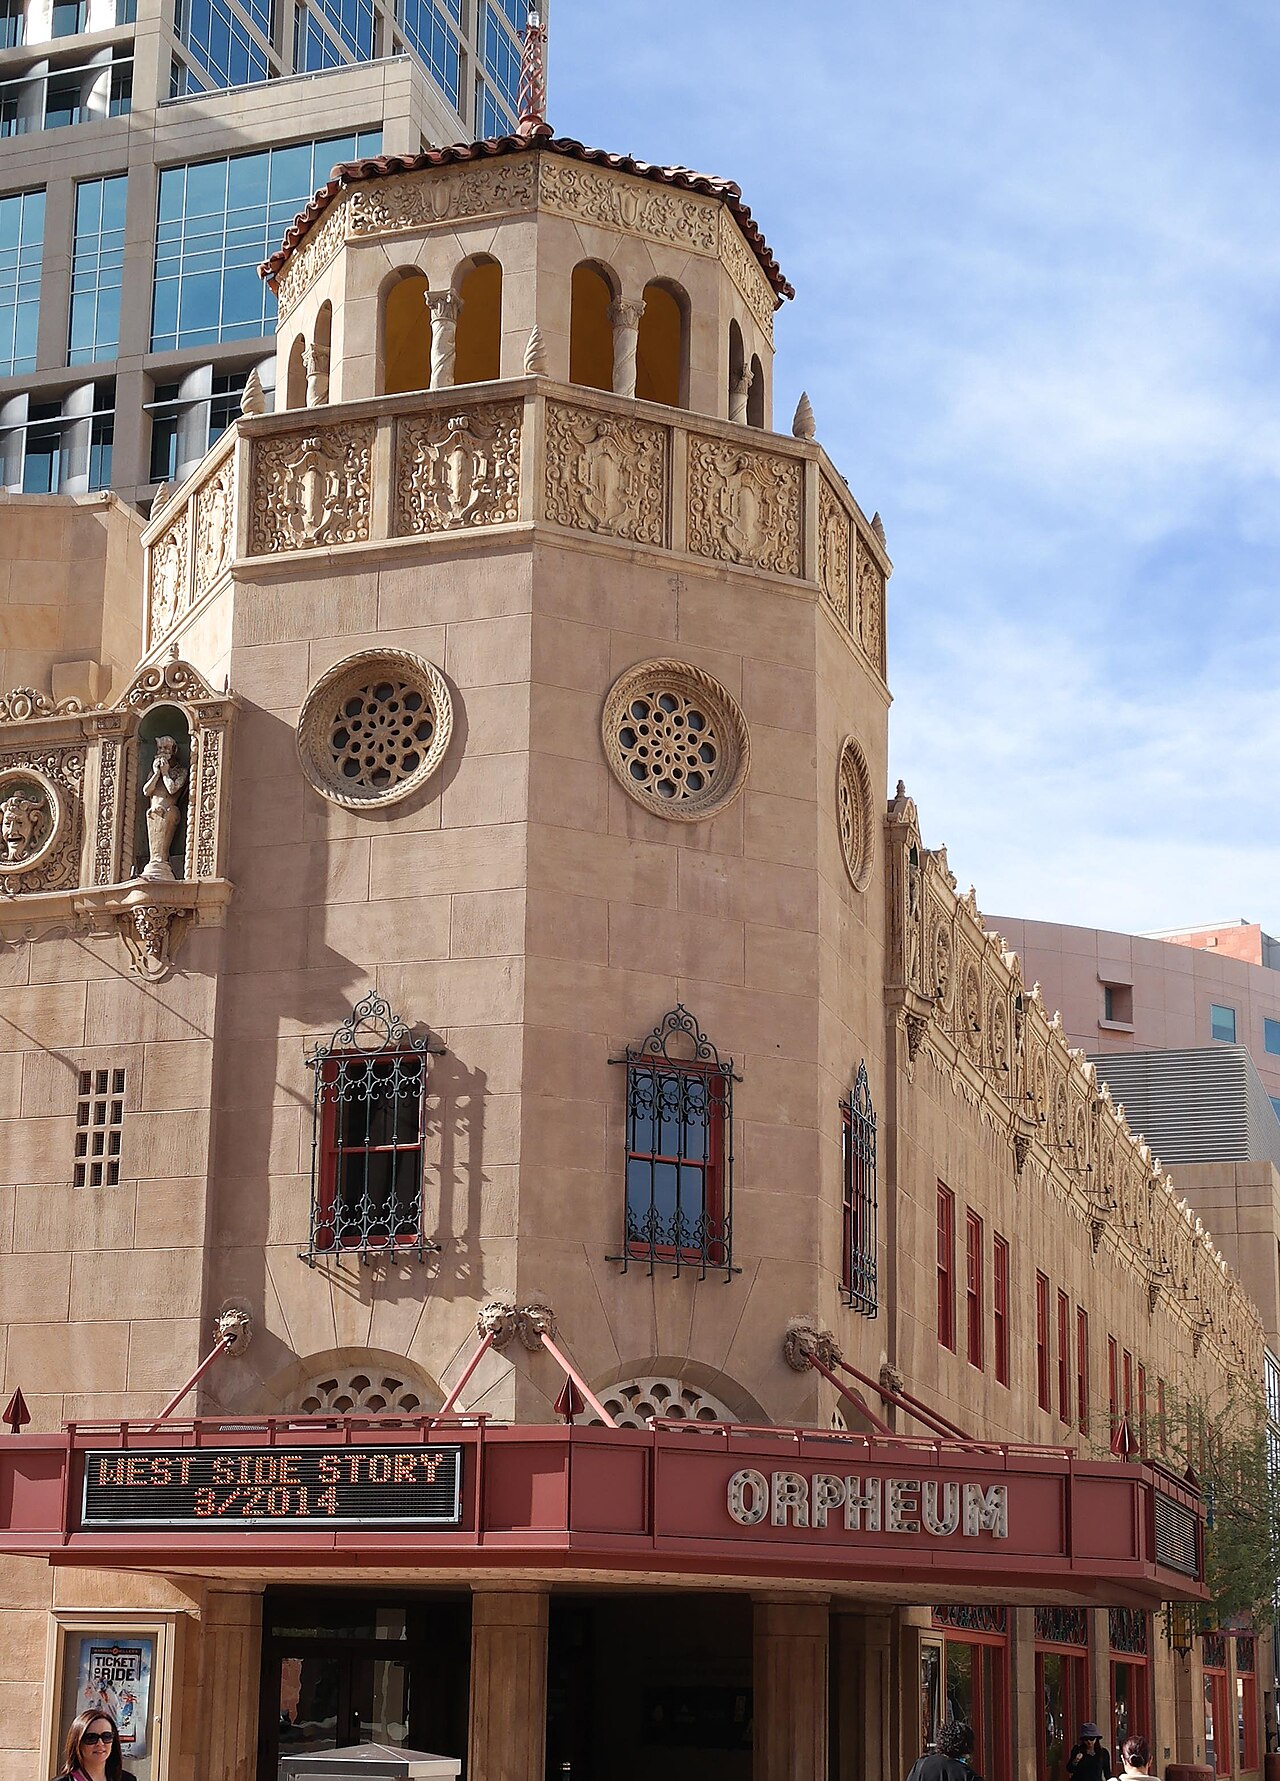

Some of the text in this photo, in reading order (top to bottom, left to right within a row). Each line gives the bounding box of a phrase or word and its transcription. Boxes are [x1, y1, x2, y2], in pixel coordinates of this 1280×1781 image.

[98, 1453, 443, 1485] WEST SIDE STORY
[194, 1487, 340, 1516] 3/2014
[727, 1468, 1009, 1539] ORPHEUM
[95, 1656, 135, 1667] TICKET
[102, 1668, 135, 1681] RIDE
